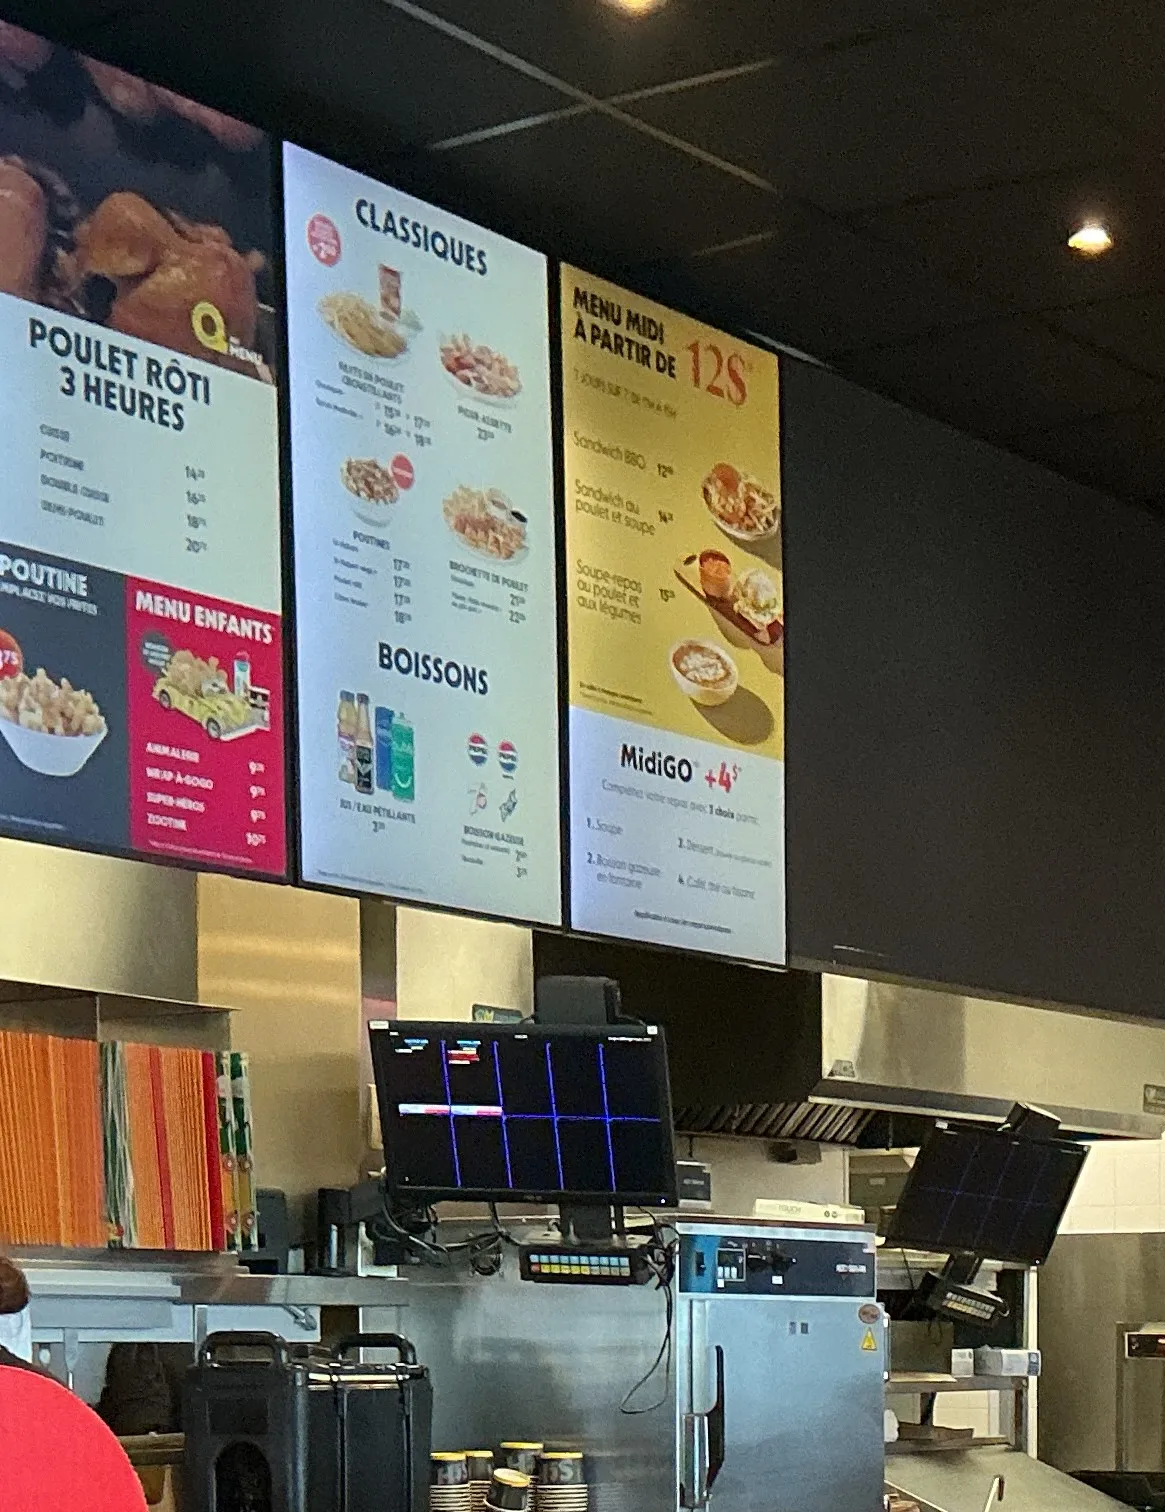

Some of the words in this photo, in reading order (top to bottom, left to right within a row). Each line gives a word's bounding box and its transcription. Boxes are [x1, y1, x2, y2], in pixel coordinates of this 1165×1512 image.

[355, 198, 488, 276] CLASSIQUES
[573, 286, 622, 327] MENU
[625, 308, 665, 345] MIDI
[29, 317, 138, 380] POULET
[147, 359, 211, 405] RÔTI
[573, 311, 587, 343] À
[590, 323, 651, 370] PARTIR
[655, 351, 677, 380] DE
[60, 366, 76, 397] 3
[84, 373, 185, 431] HEURES
[573, 430, 623, 461] Sandwich
[575, 478, 624, 508] Sandwich
[576, 499, 609, 520] poulet
[624, 516, 656, 536] soupe
[0, 554, 88, 597] POUTINE
[593, 584, 627, 605] poulet
[136, 590, 191, 623] MENU
[195, 605, 273, 645] ENFANTS
[378, 642, 489, 695] BOISSONS
[620, 743, 693, 783] MidiGO
